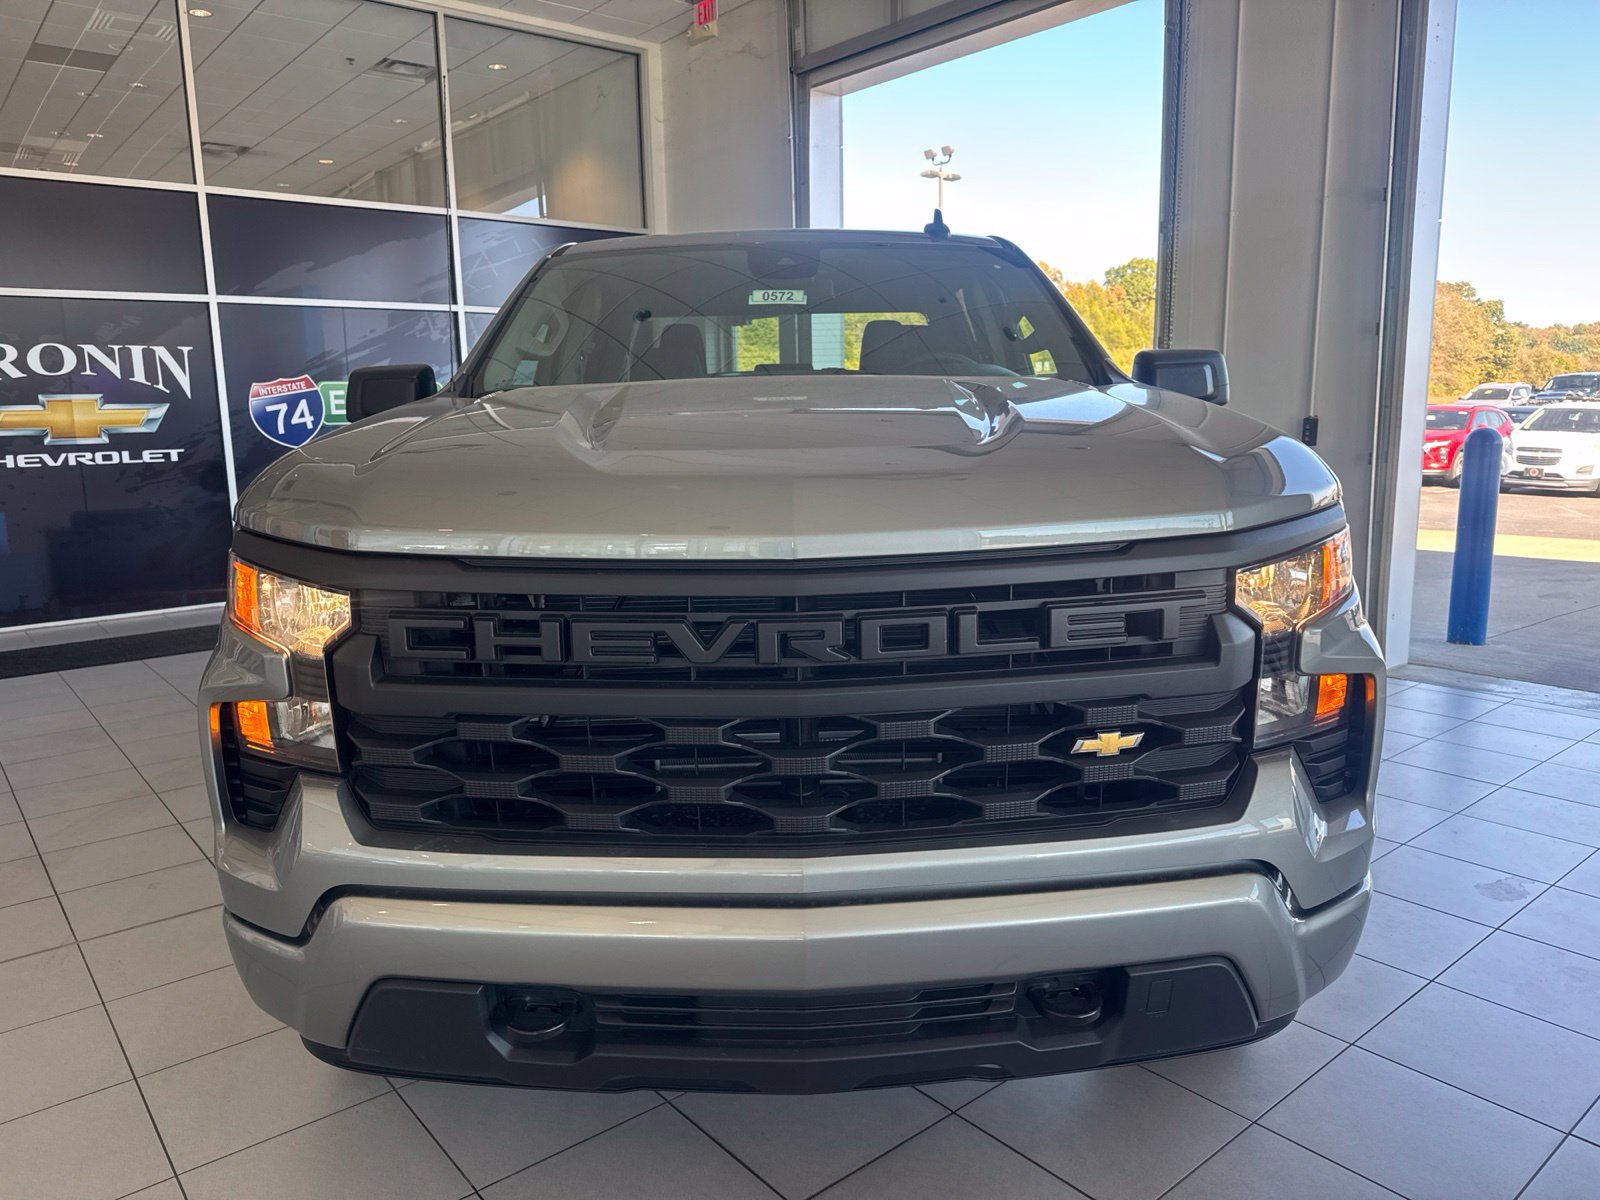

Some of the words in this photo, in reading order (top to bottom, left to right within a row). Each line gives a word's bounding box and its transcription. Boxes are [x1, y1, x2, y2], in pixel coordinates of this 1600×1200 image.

[762, 291, 794, 301] 0572
[259, 381, 306, 396] INTERSTATE
[265, 399, 315, 434] 74
[388, 594, 1206, 666] CHEVROLET
